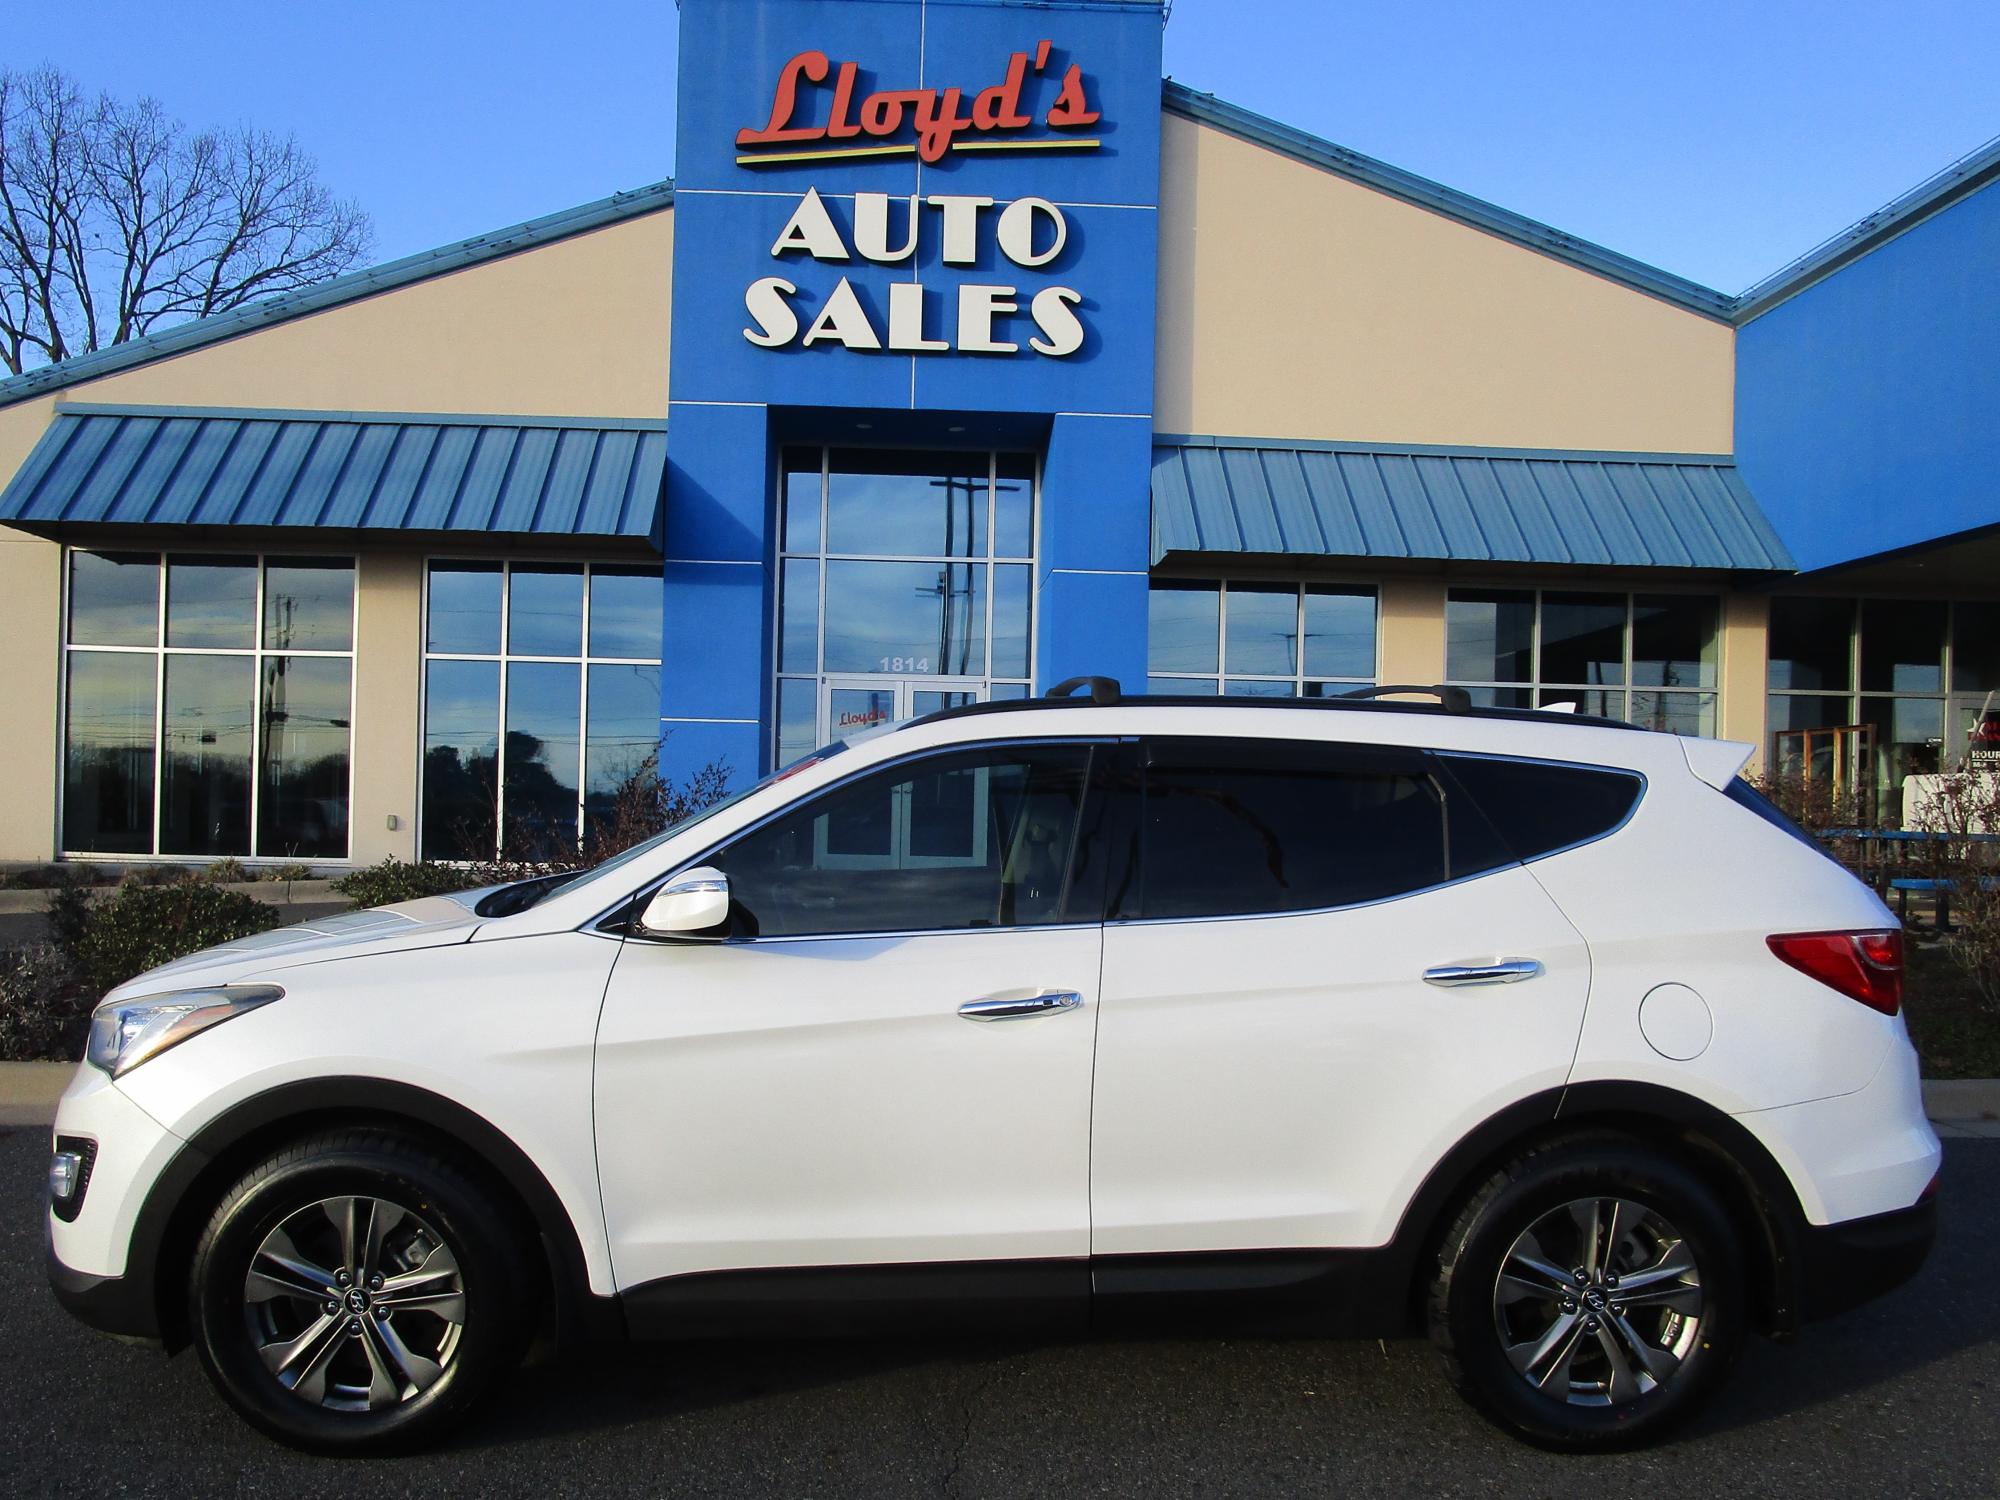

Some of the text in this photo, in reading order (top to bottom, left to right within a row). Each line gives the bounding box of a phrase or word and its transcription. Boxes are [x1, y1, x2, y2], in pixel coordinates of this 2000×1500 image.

[735, 39, 1101, 163] Lloyd's
[770, 185, 1067, 267] AUTO
[742, 276, 1084, 356] SALES
[879, 656, 929, 673] 1814
[839, 708, 887, 726] Lloyds
